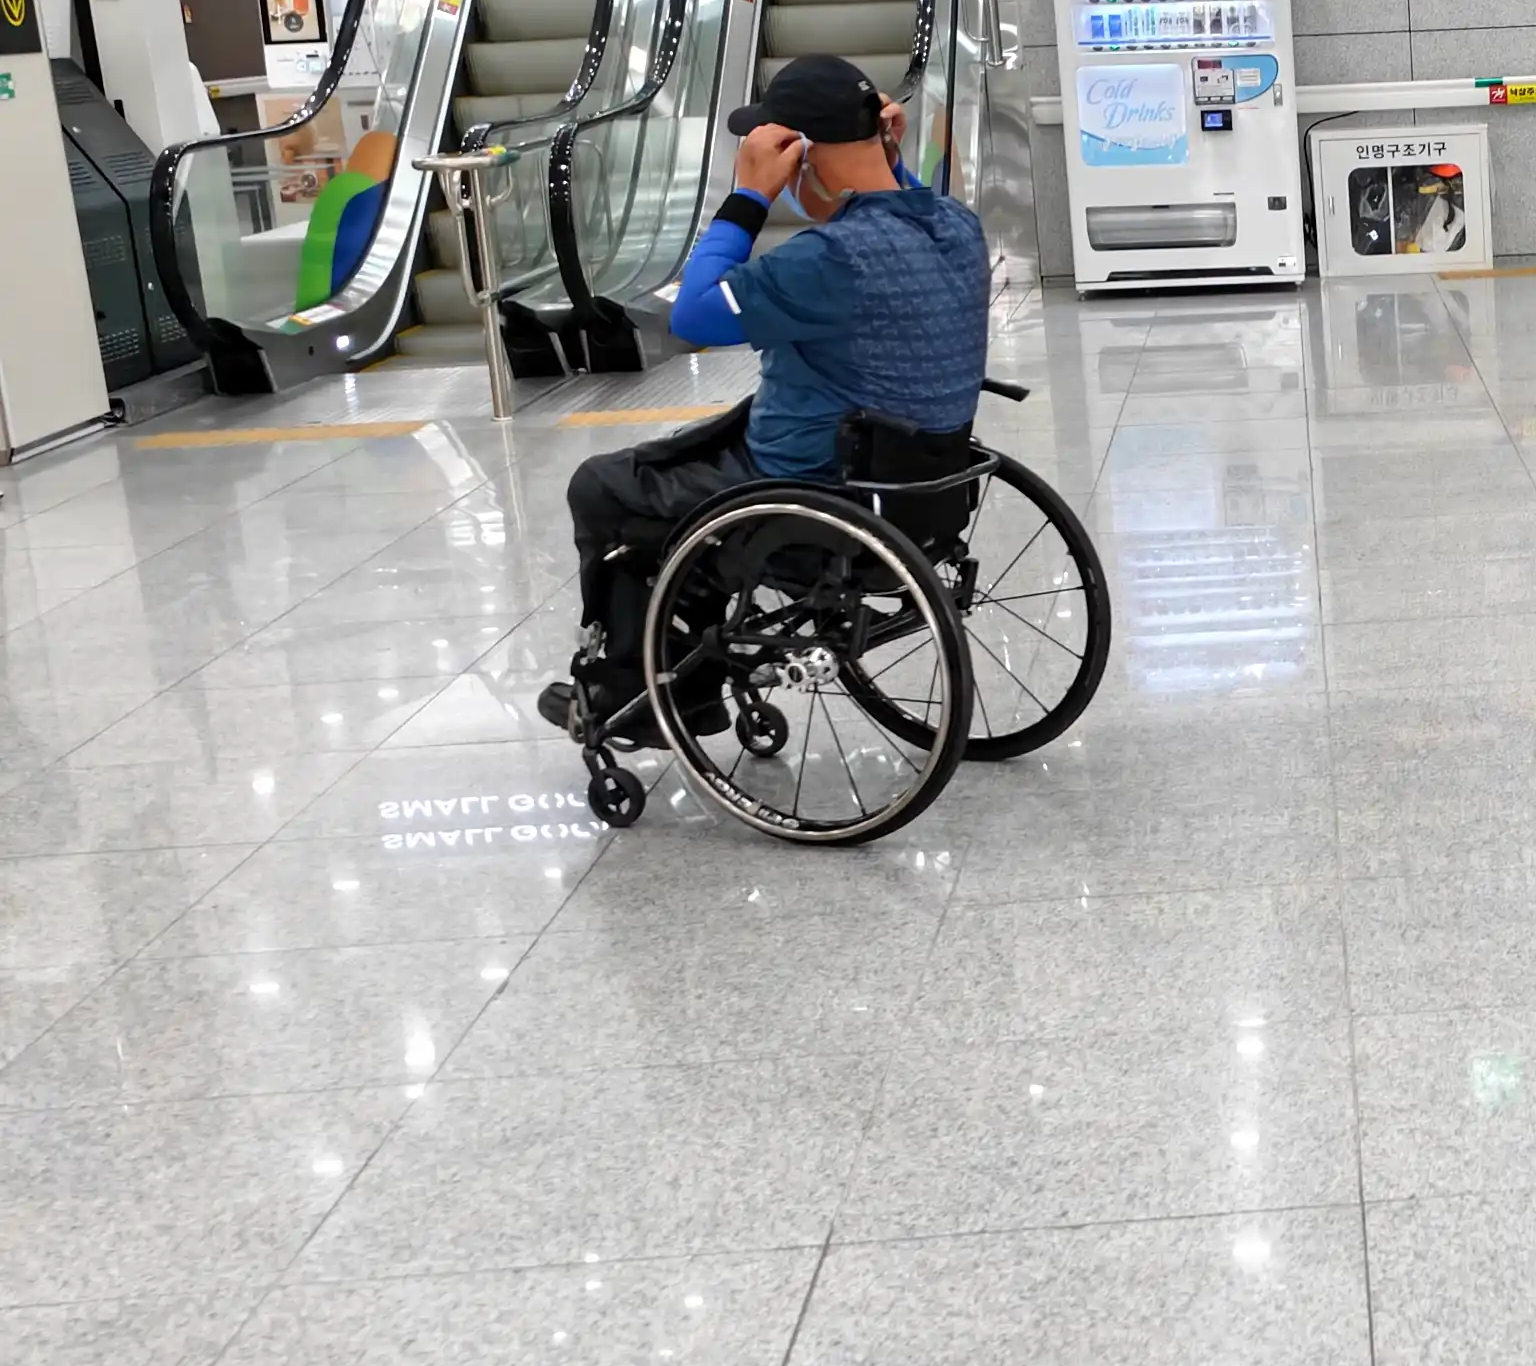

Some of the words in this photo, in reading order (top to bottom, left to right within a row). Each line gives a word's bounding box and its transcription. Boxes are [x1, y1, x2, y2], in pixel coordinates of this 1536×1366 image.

[1086, 78, 1140, 106] Cold
[1103, 100, 1176, 131] Drinks
[1356, 141, 1447, 160] 인명구조기구
